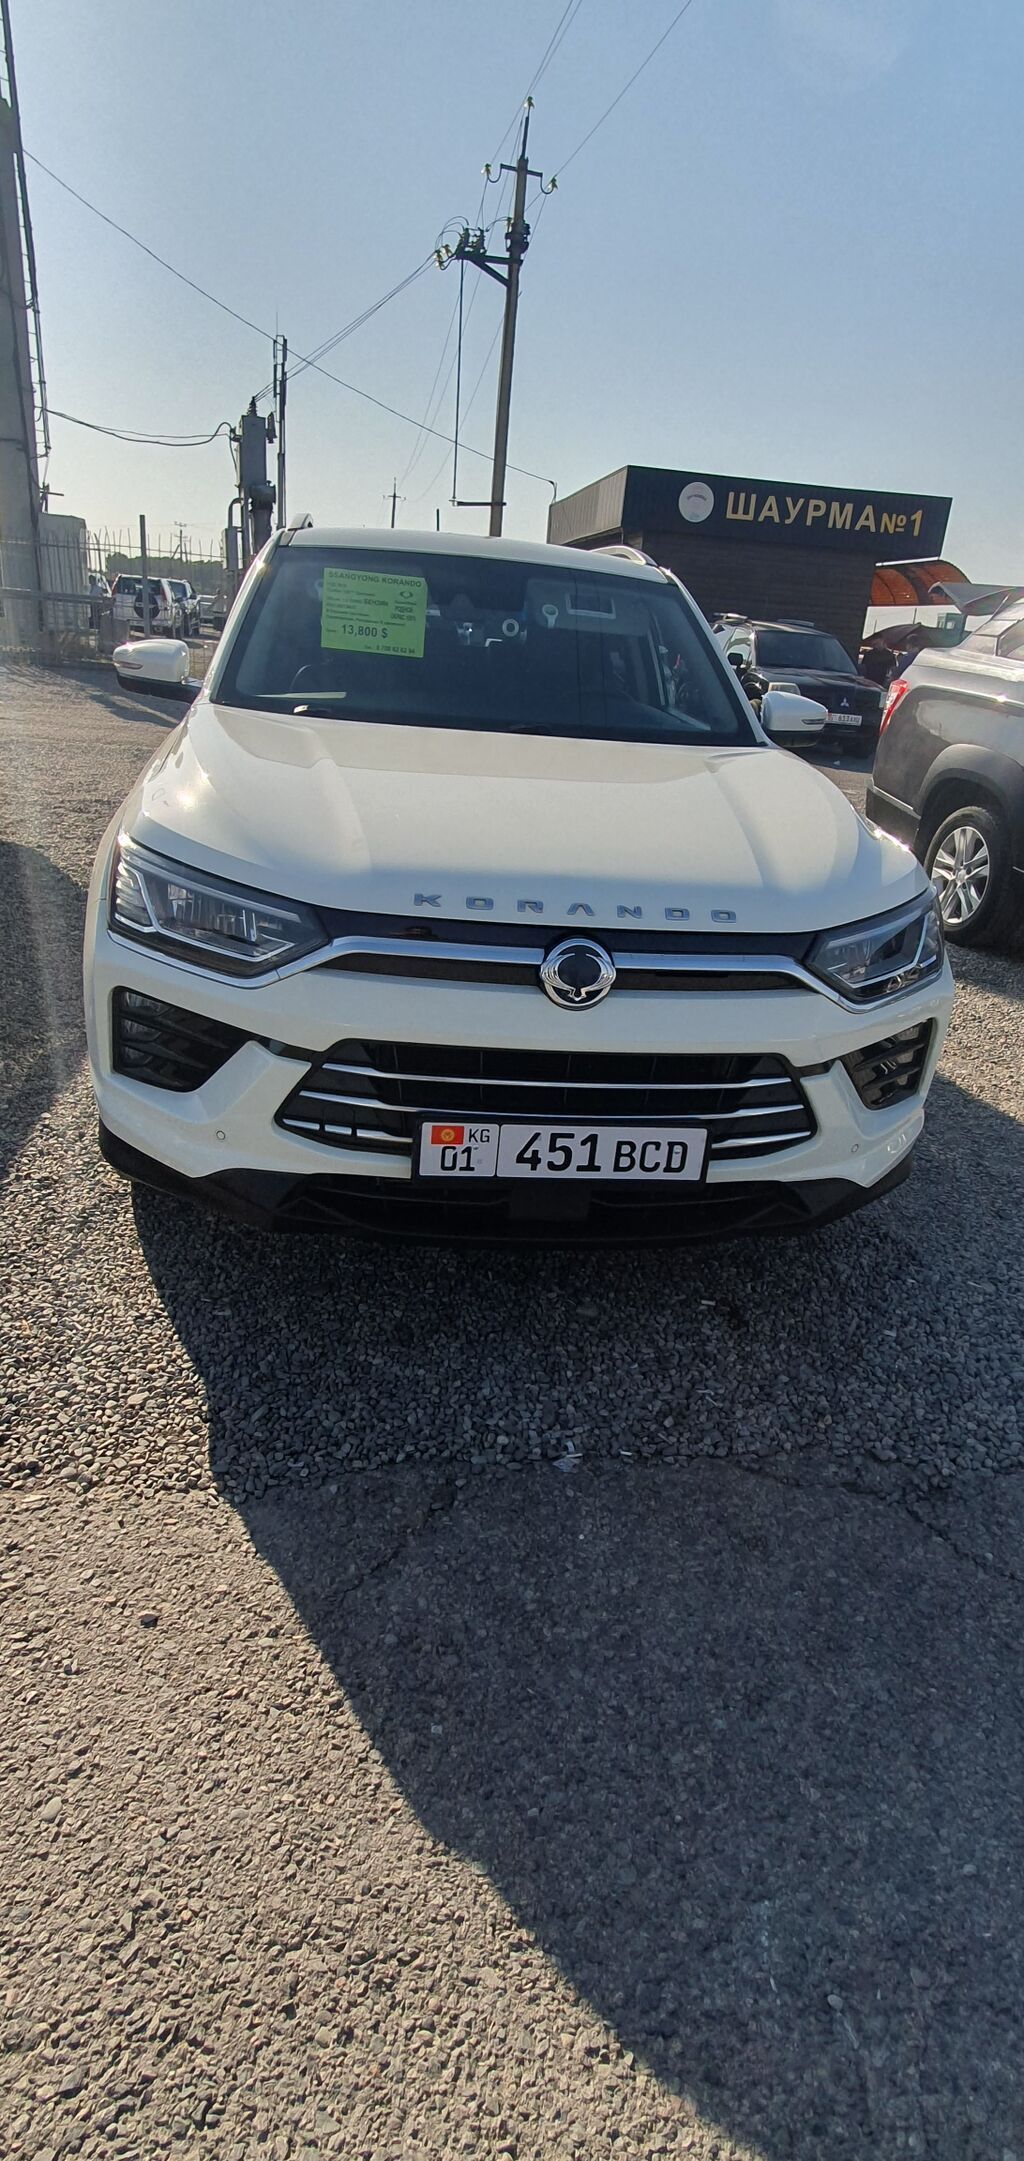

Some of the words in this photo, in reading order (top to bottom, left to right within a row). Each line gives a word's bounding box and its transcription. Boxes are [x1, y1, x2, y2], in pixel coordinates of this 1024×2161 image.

[726, 491, 876, 533] ШАУРМА
[328, 571, 380, 583] SSANGYONG
[381, 576, 422, 588] KORANDO
[342, 624, 378, 638] 13,800
[381, 627, 389, 639] $
[413, 892, 738, 924] KORANDO
[468, 1128, 491, 1144] KG
[440, 1145, 476, 1172] 01
[515, 1132, 602, 1173] 451
[612, 1140, 689, 1173] BCD
